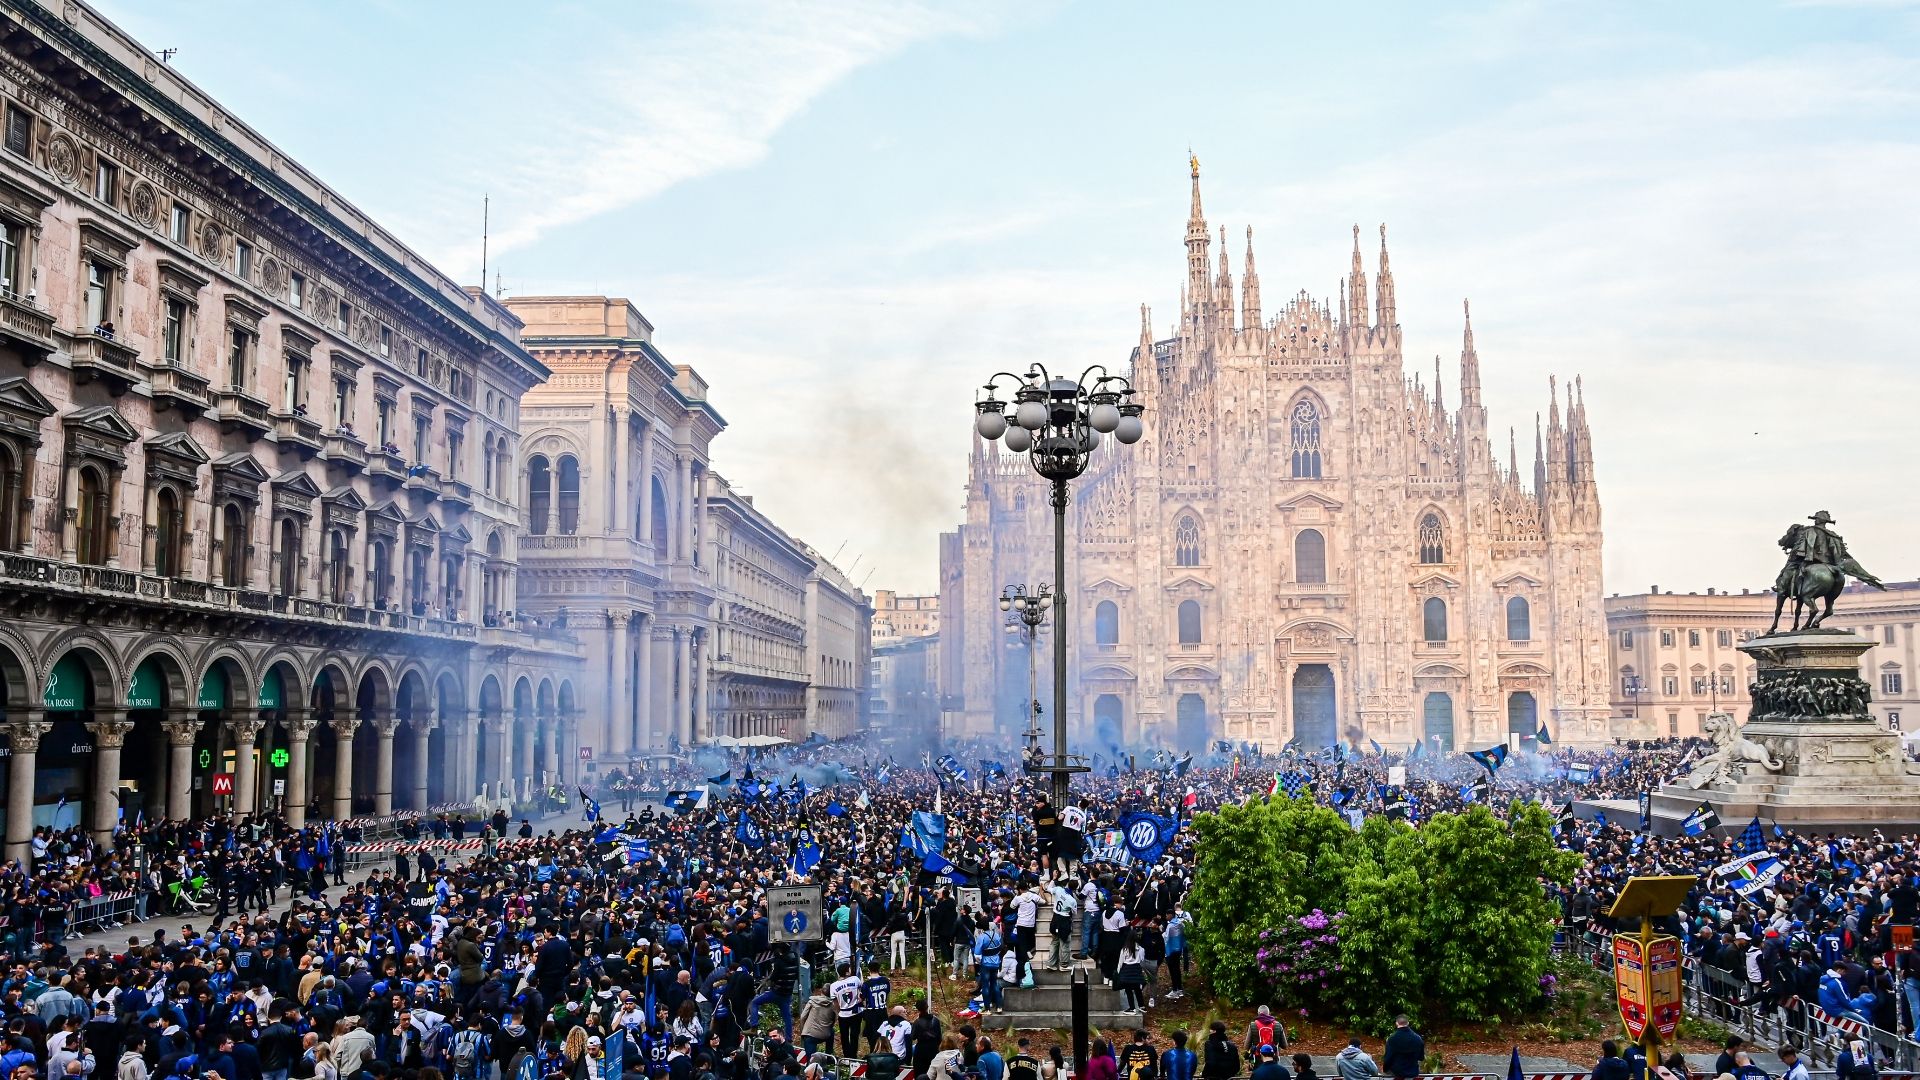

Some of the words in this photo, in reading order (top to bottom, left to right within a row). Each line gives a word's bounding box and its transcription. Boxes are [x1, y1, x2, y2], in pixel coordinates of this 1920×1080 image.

[55, 698, 74, 707] ROSSI
[135, 698, 152, 707] ROSSI
[202, 699, 217, 707] ROSSI
[71, 742, 93, 753] davis
[214, 778, 232, 791] M
[778, 898, 811, 907] pedonale
[1055, 900, 1064, 912] 6
[1830, 940, 1839, 952] 9
[484, 946, 492, 959] 9
[504, 959, 514, 970] 10
[871, 990, 887, 1009] 10
[651, 1045, 667, 1062] 95
